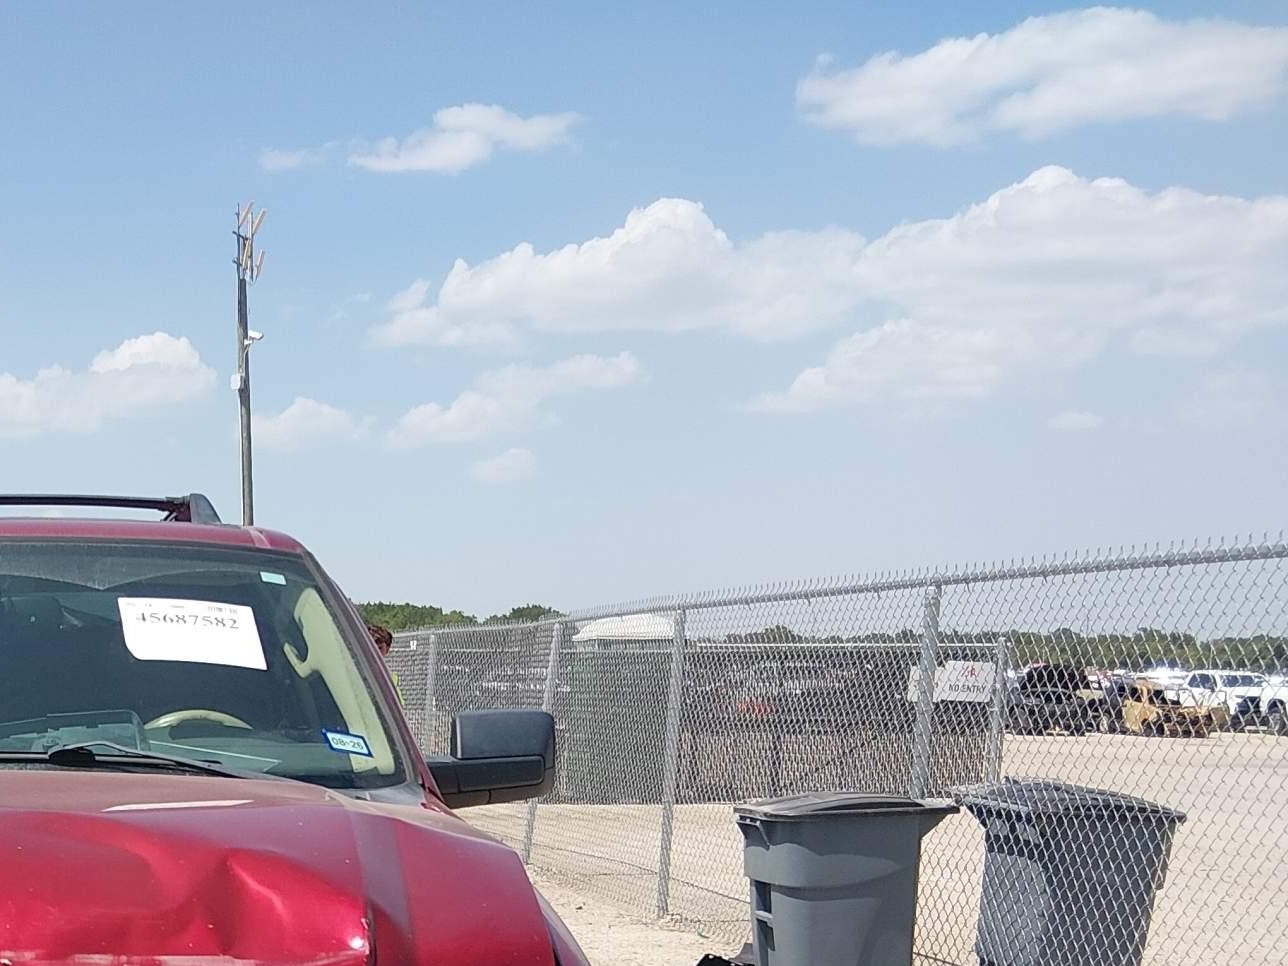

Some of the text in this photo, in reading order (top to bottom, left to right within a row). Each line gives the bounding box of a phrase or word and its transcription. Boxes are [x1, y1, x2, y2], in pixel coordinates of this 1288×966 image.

[135, 611, 240, 630] 45687582
[948, 683, 987, 694] NO ENTRY
